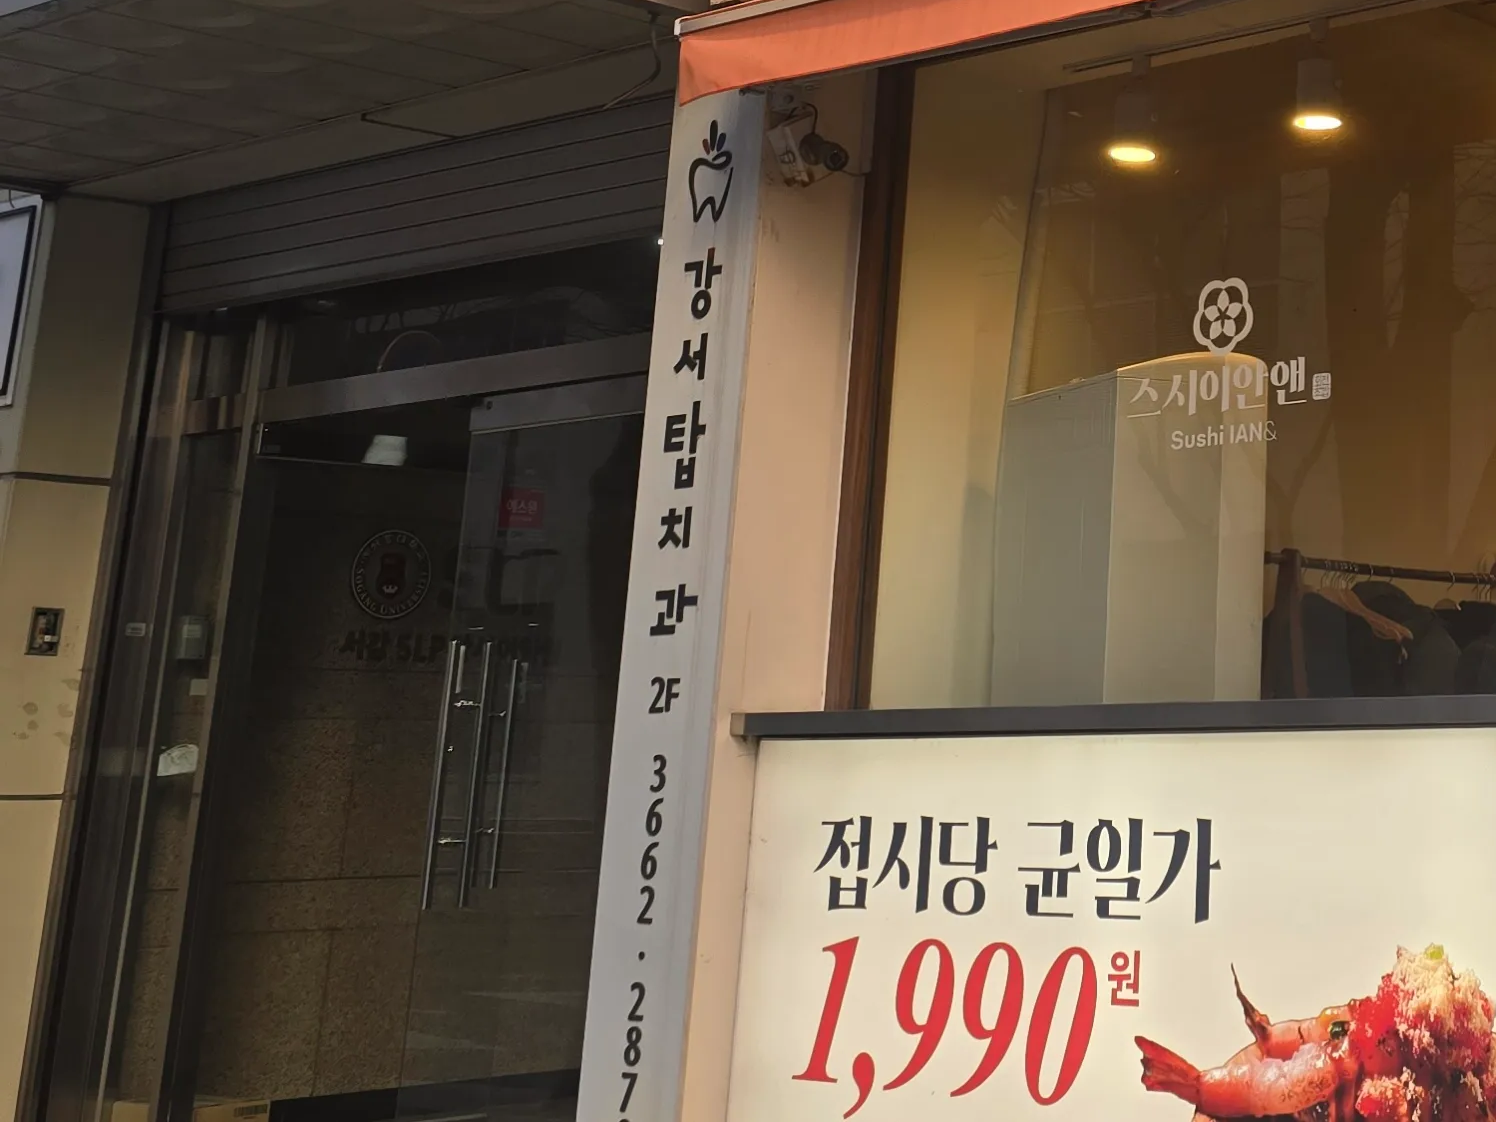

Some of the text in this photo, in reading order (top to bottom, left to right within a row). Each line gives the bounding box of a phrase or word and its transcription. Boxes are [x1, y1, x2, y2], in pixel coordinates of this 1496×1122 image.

[1126, 356, 1308, 419] 스시이안앤
[649, 247, 723, 637] 강서탑치과
[1170, 419, 1278, 450] Sushi IAN&
[647, 676, 681, 715] 2F
[812, 815, 1222, 925] 접시당 균일가
